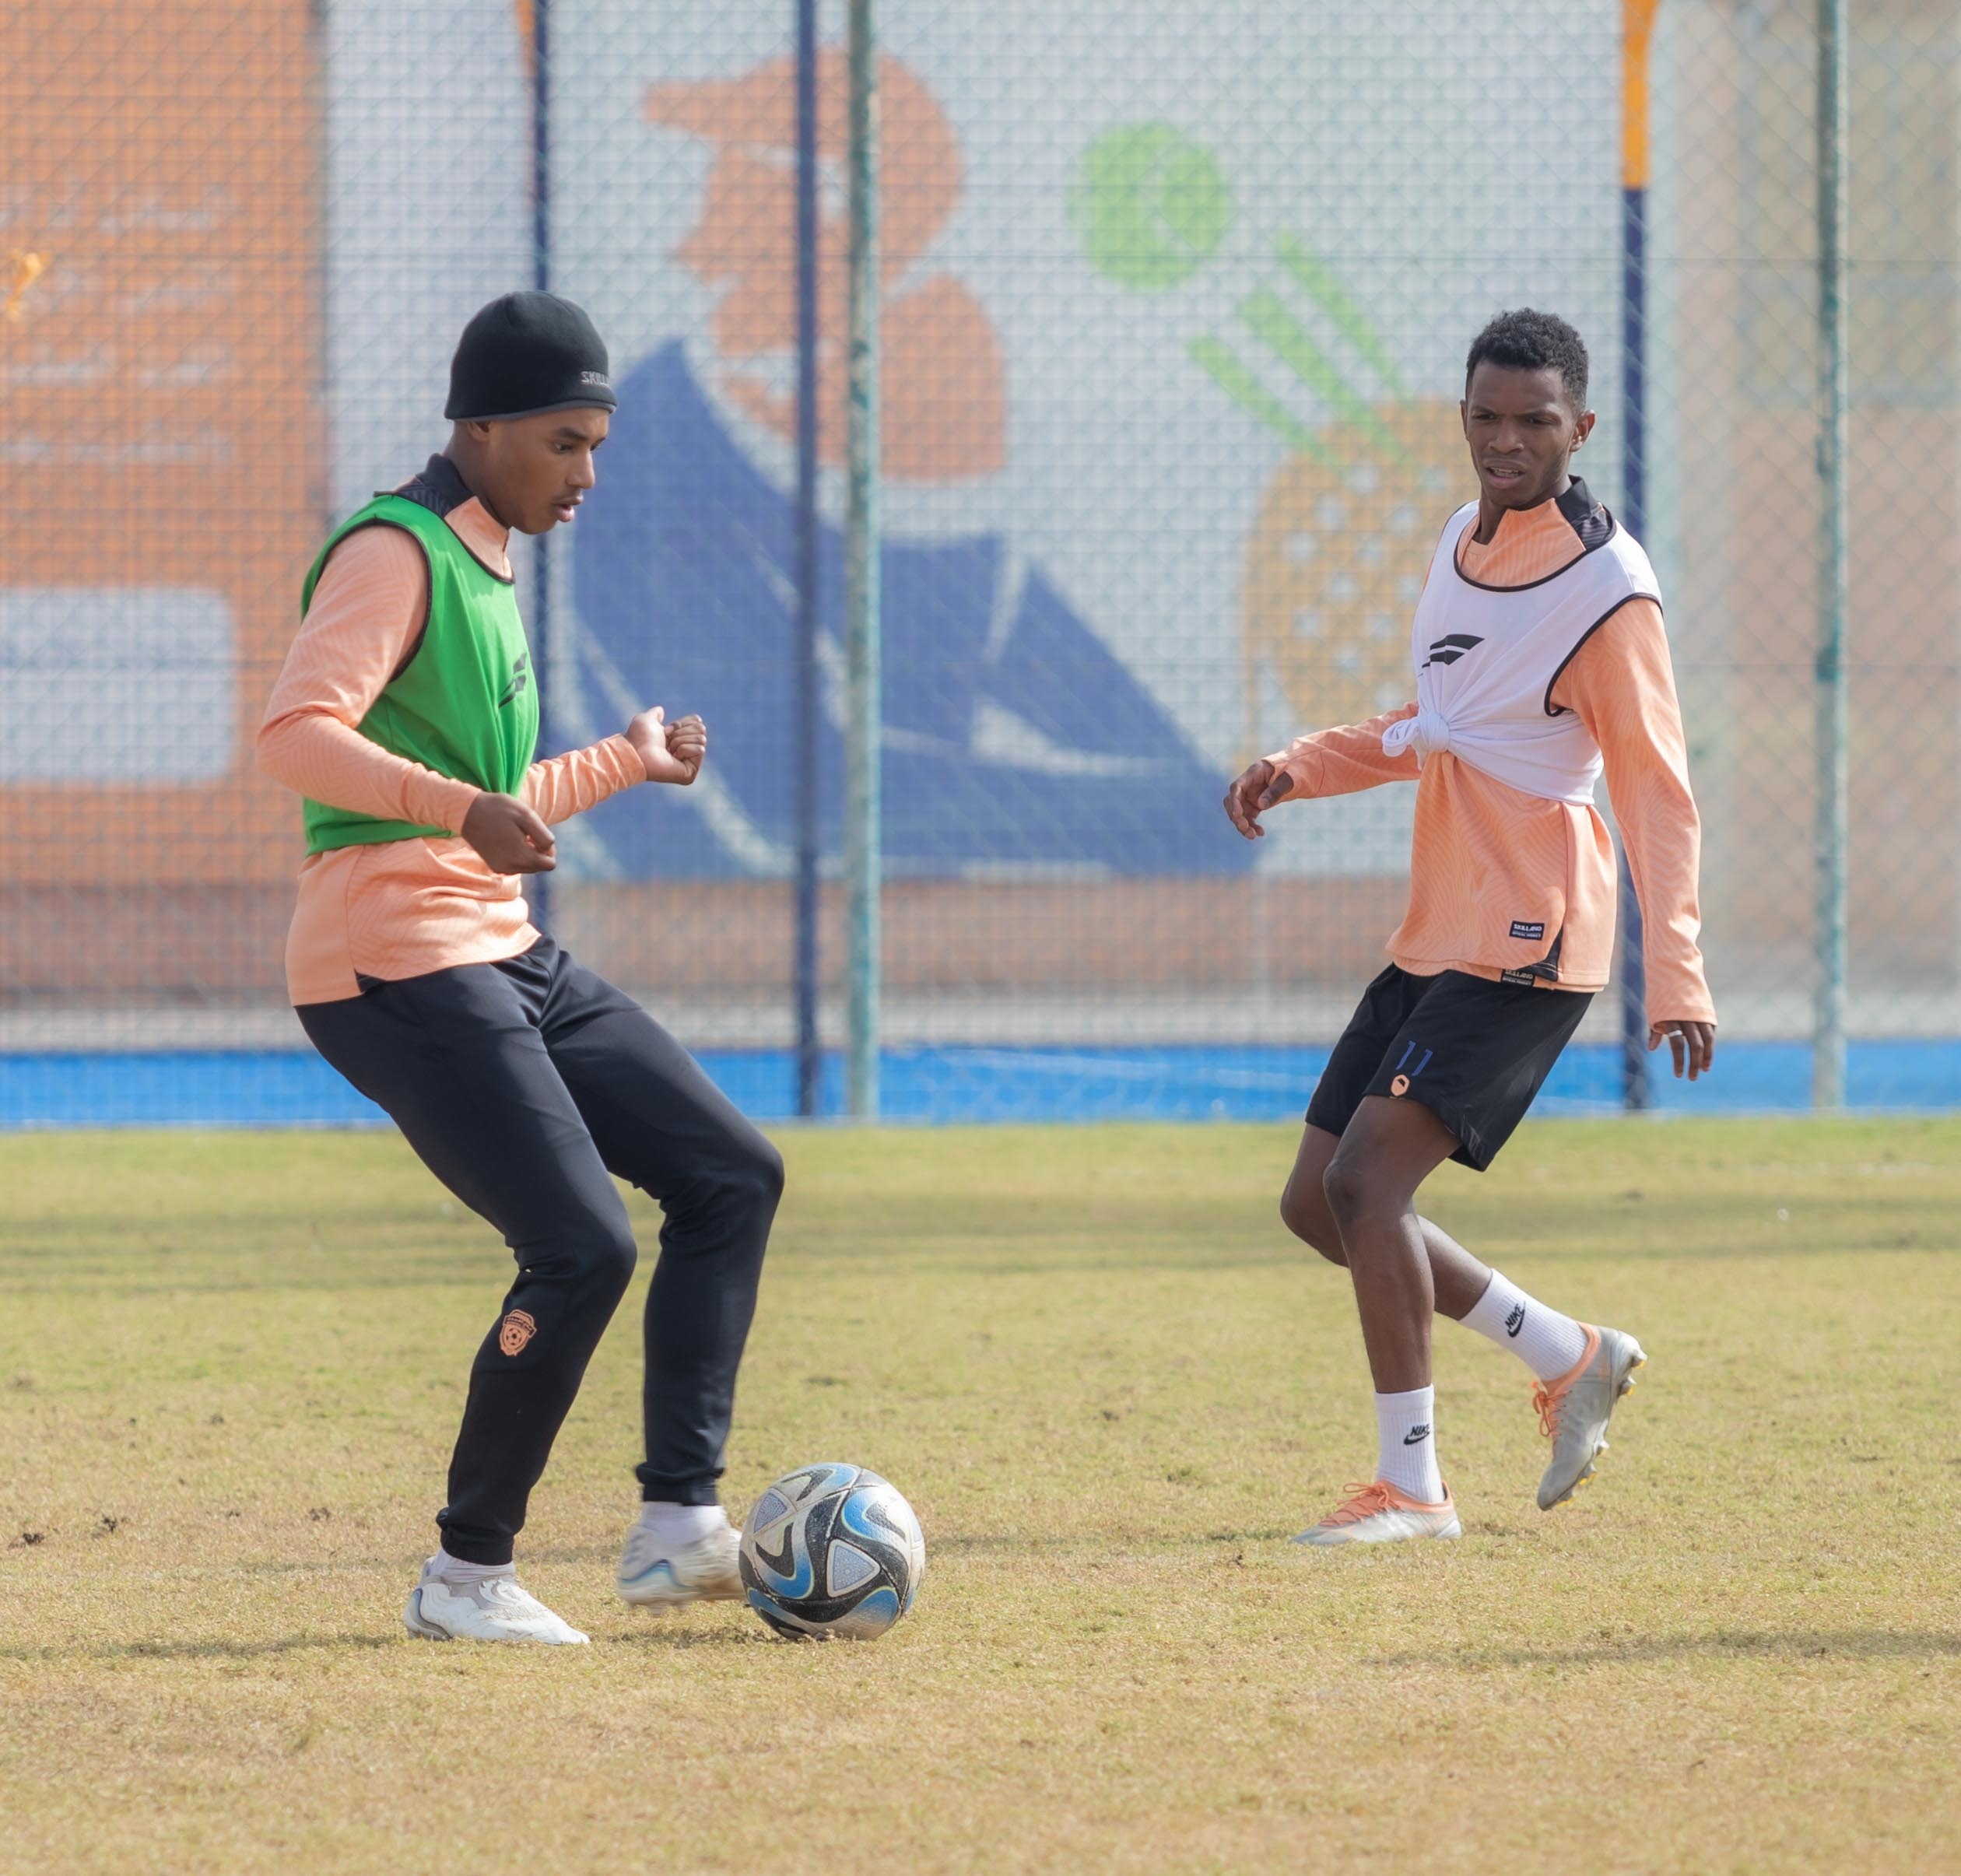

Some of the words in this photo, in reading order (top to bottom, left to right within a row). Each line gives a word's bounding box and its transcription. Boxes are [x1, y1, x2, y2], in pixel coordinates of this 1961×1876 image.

[1395, 1040, 1433, 1076] 11
[1504, 1303, 1524, 1329] NIKE
[1410, 1424, 1430, 1436] NIKE
